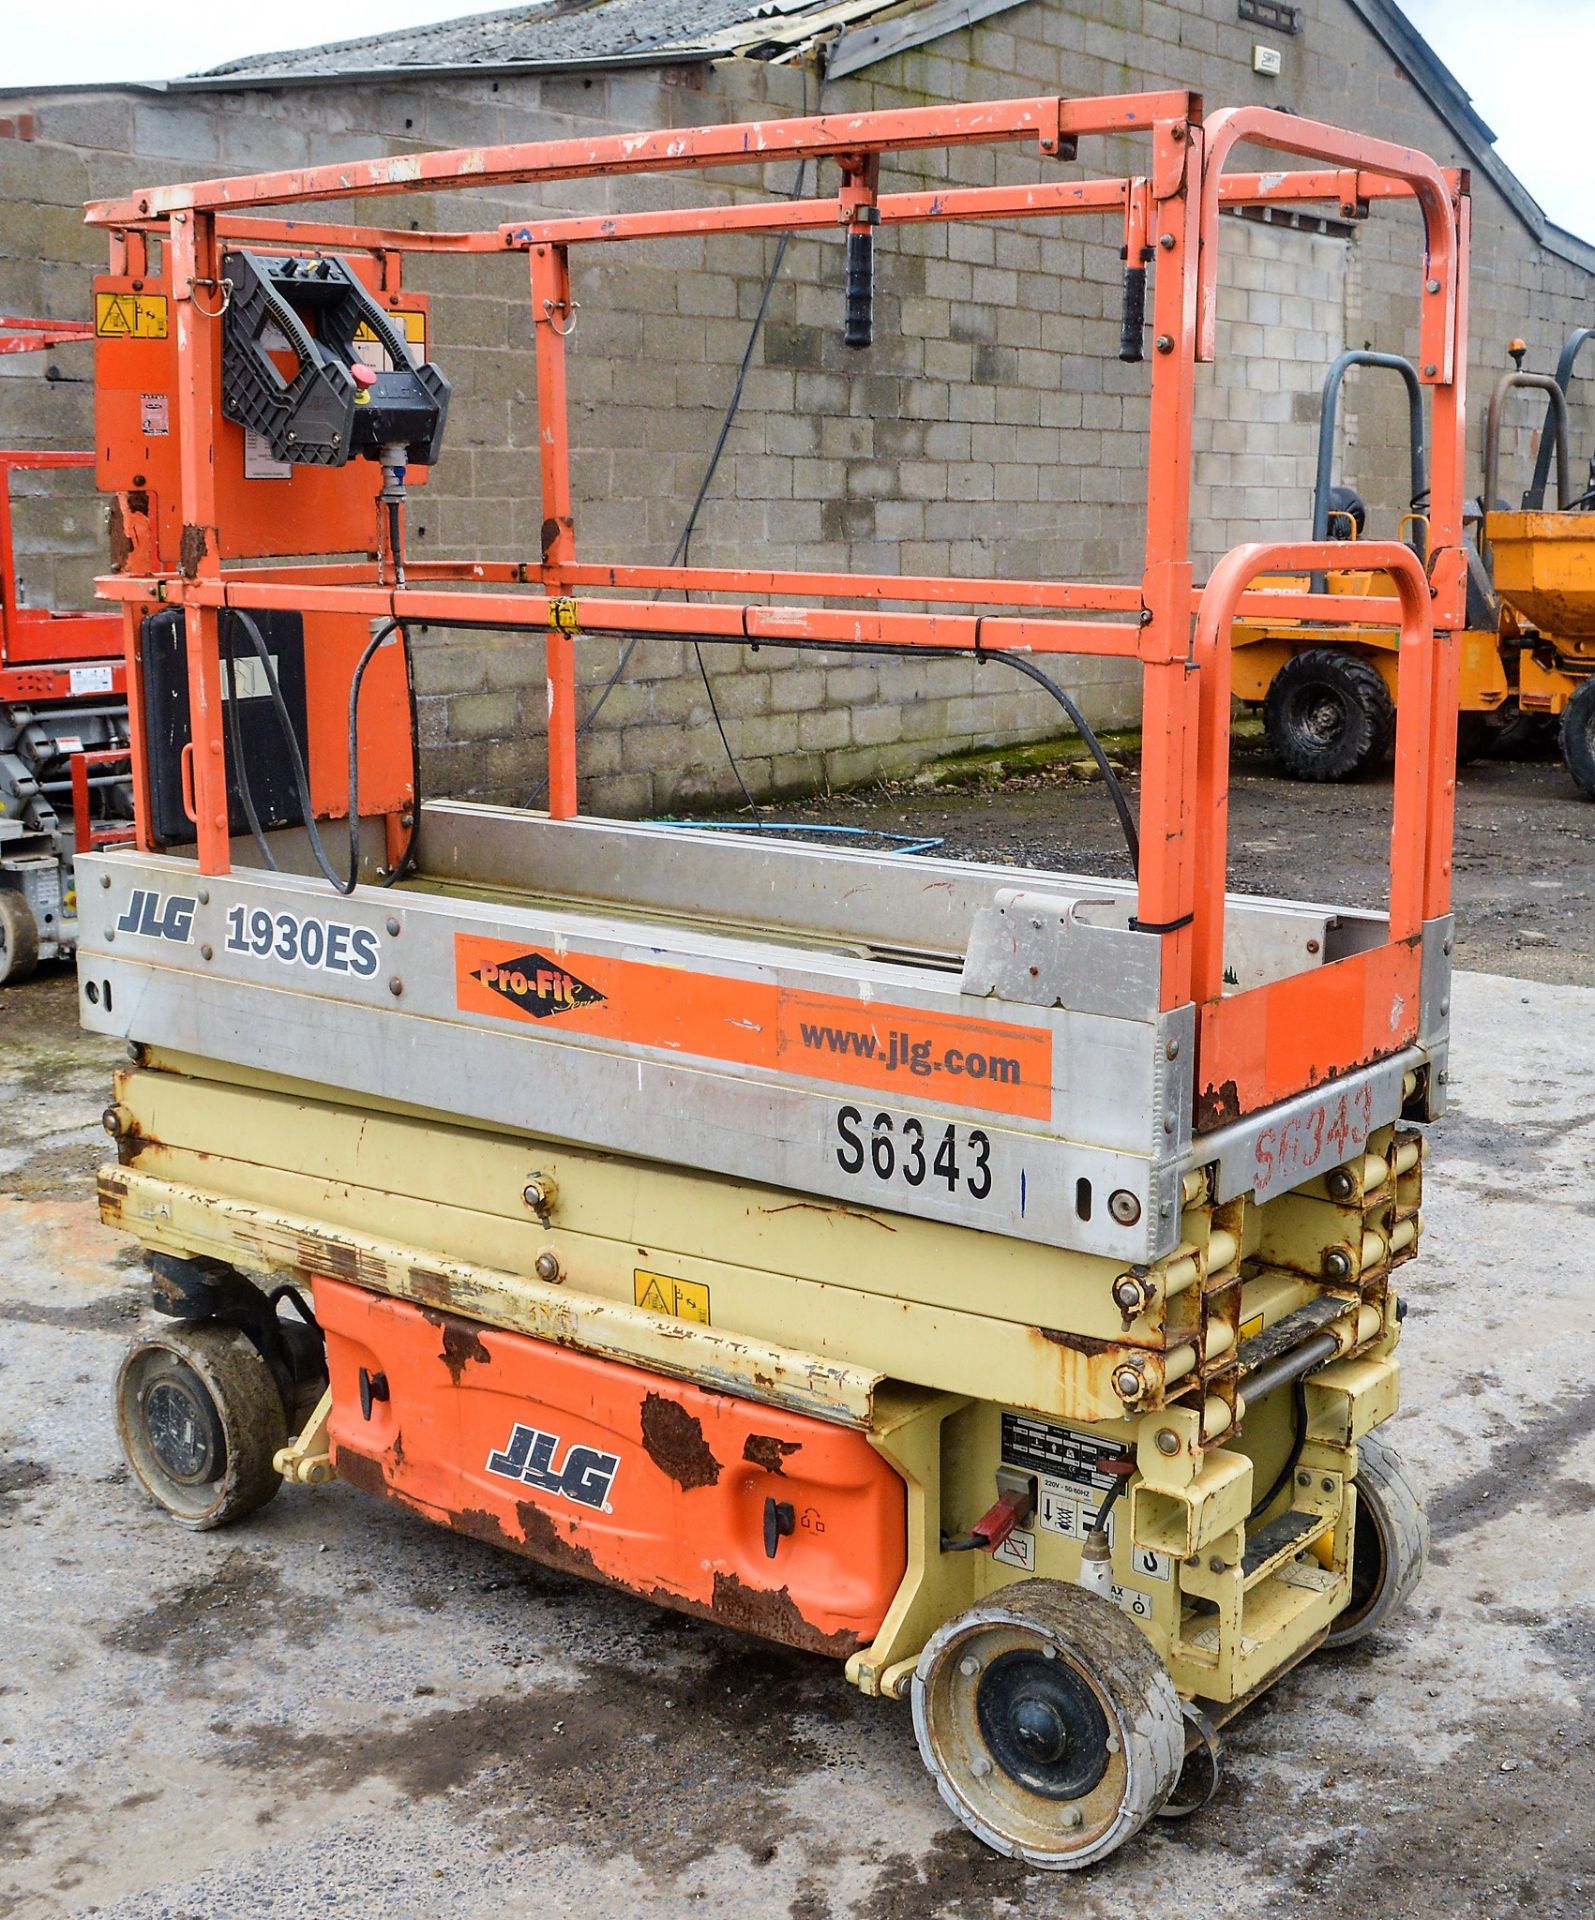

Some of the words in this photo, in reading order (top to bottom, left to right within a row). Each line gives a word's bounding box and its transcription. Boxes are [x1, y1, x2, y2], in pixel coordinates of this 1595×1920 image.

[116, 889, 198, 942] JLG
[226, 905, 379, 977] 1930ES
[480, 959, 575, 1004] Pro-Fit
[799, 1023, 1021, 1085] www.jlg.com
[836, 1104, 992, 1200] S6343
[1252, 1081, 1372, 1190] S6343
[486, 1423, 620, 1508] JLG
[1044, 1479, 1060, 1489] 220V
